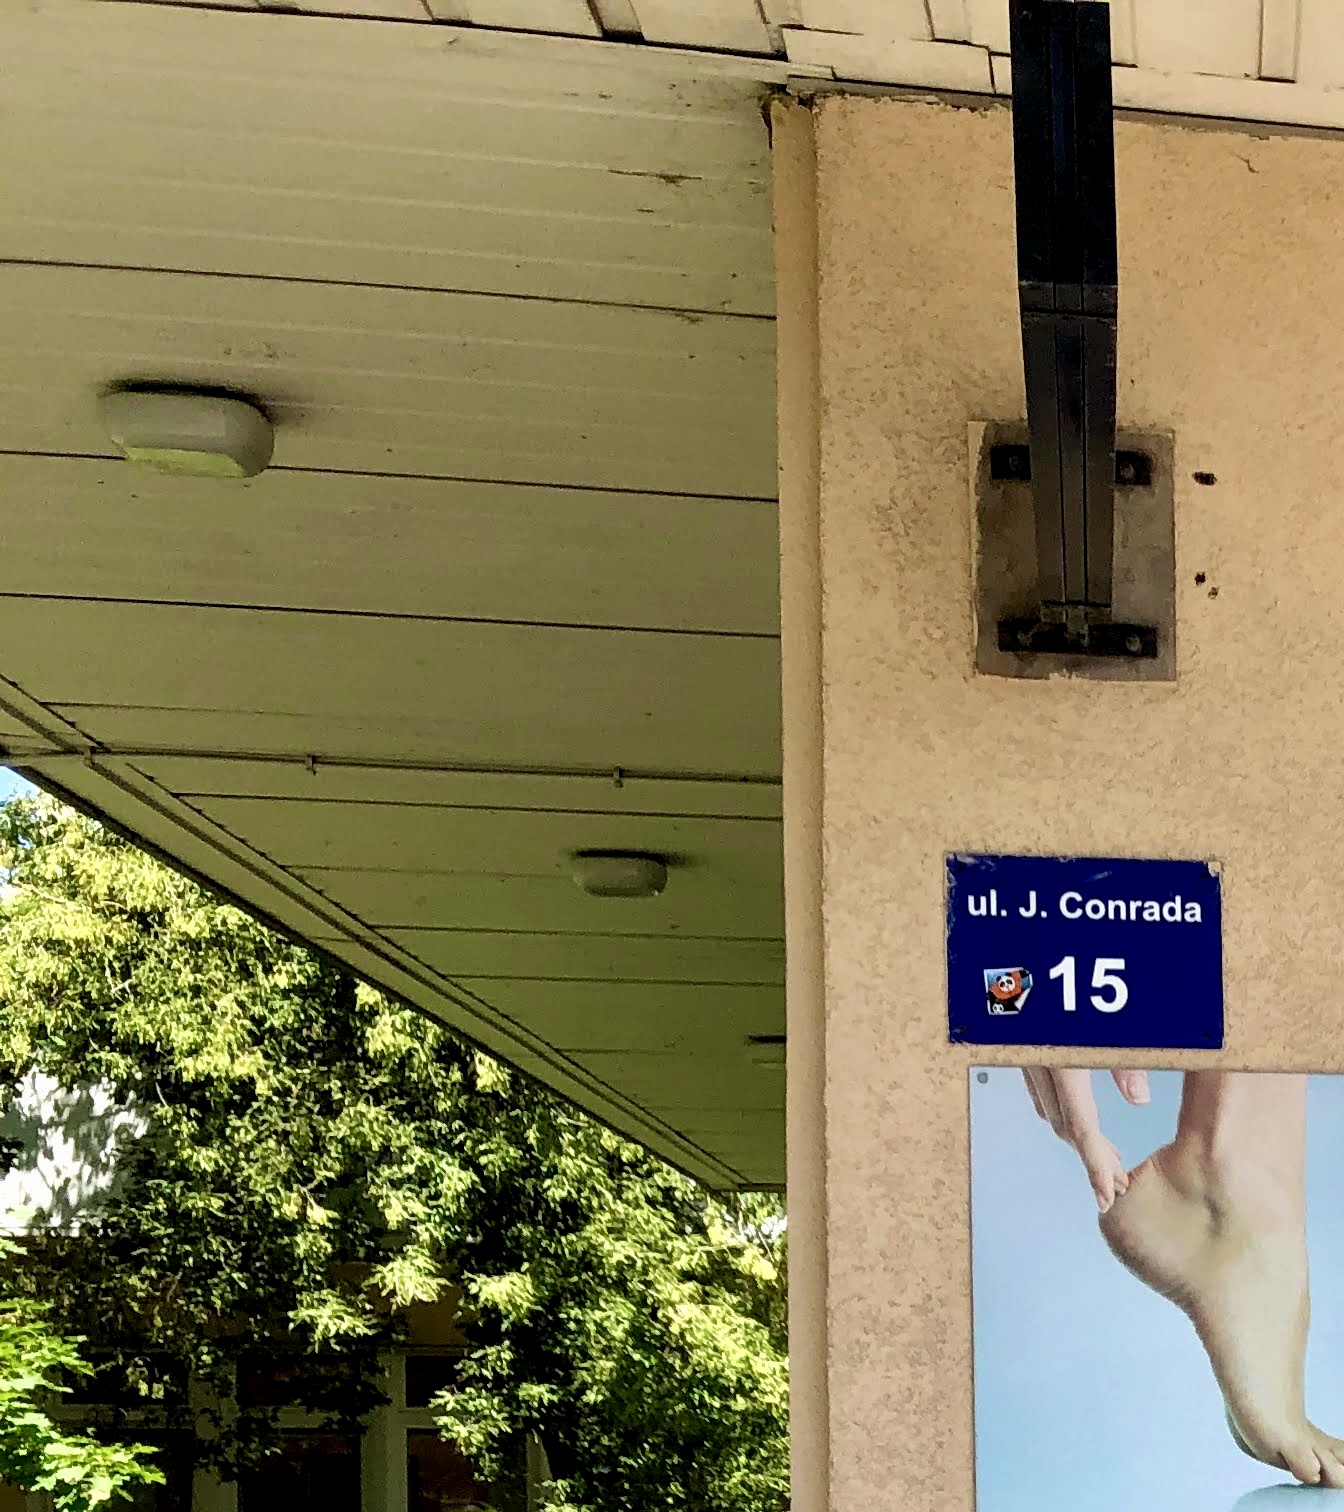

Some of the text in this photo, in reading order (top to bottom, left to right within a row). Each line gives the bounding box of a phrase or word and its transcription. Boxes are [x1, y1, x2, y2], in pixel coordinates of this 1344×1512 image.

[968, 889, 1201, 922] ul. J. Conrada
[1050, 956, 1128, 1012] 15
